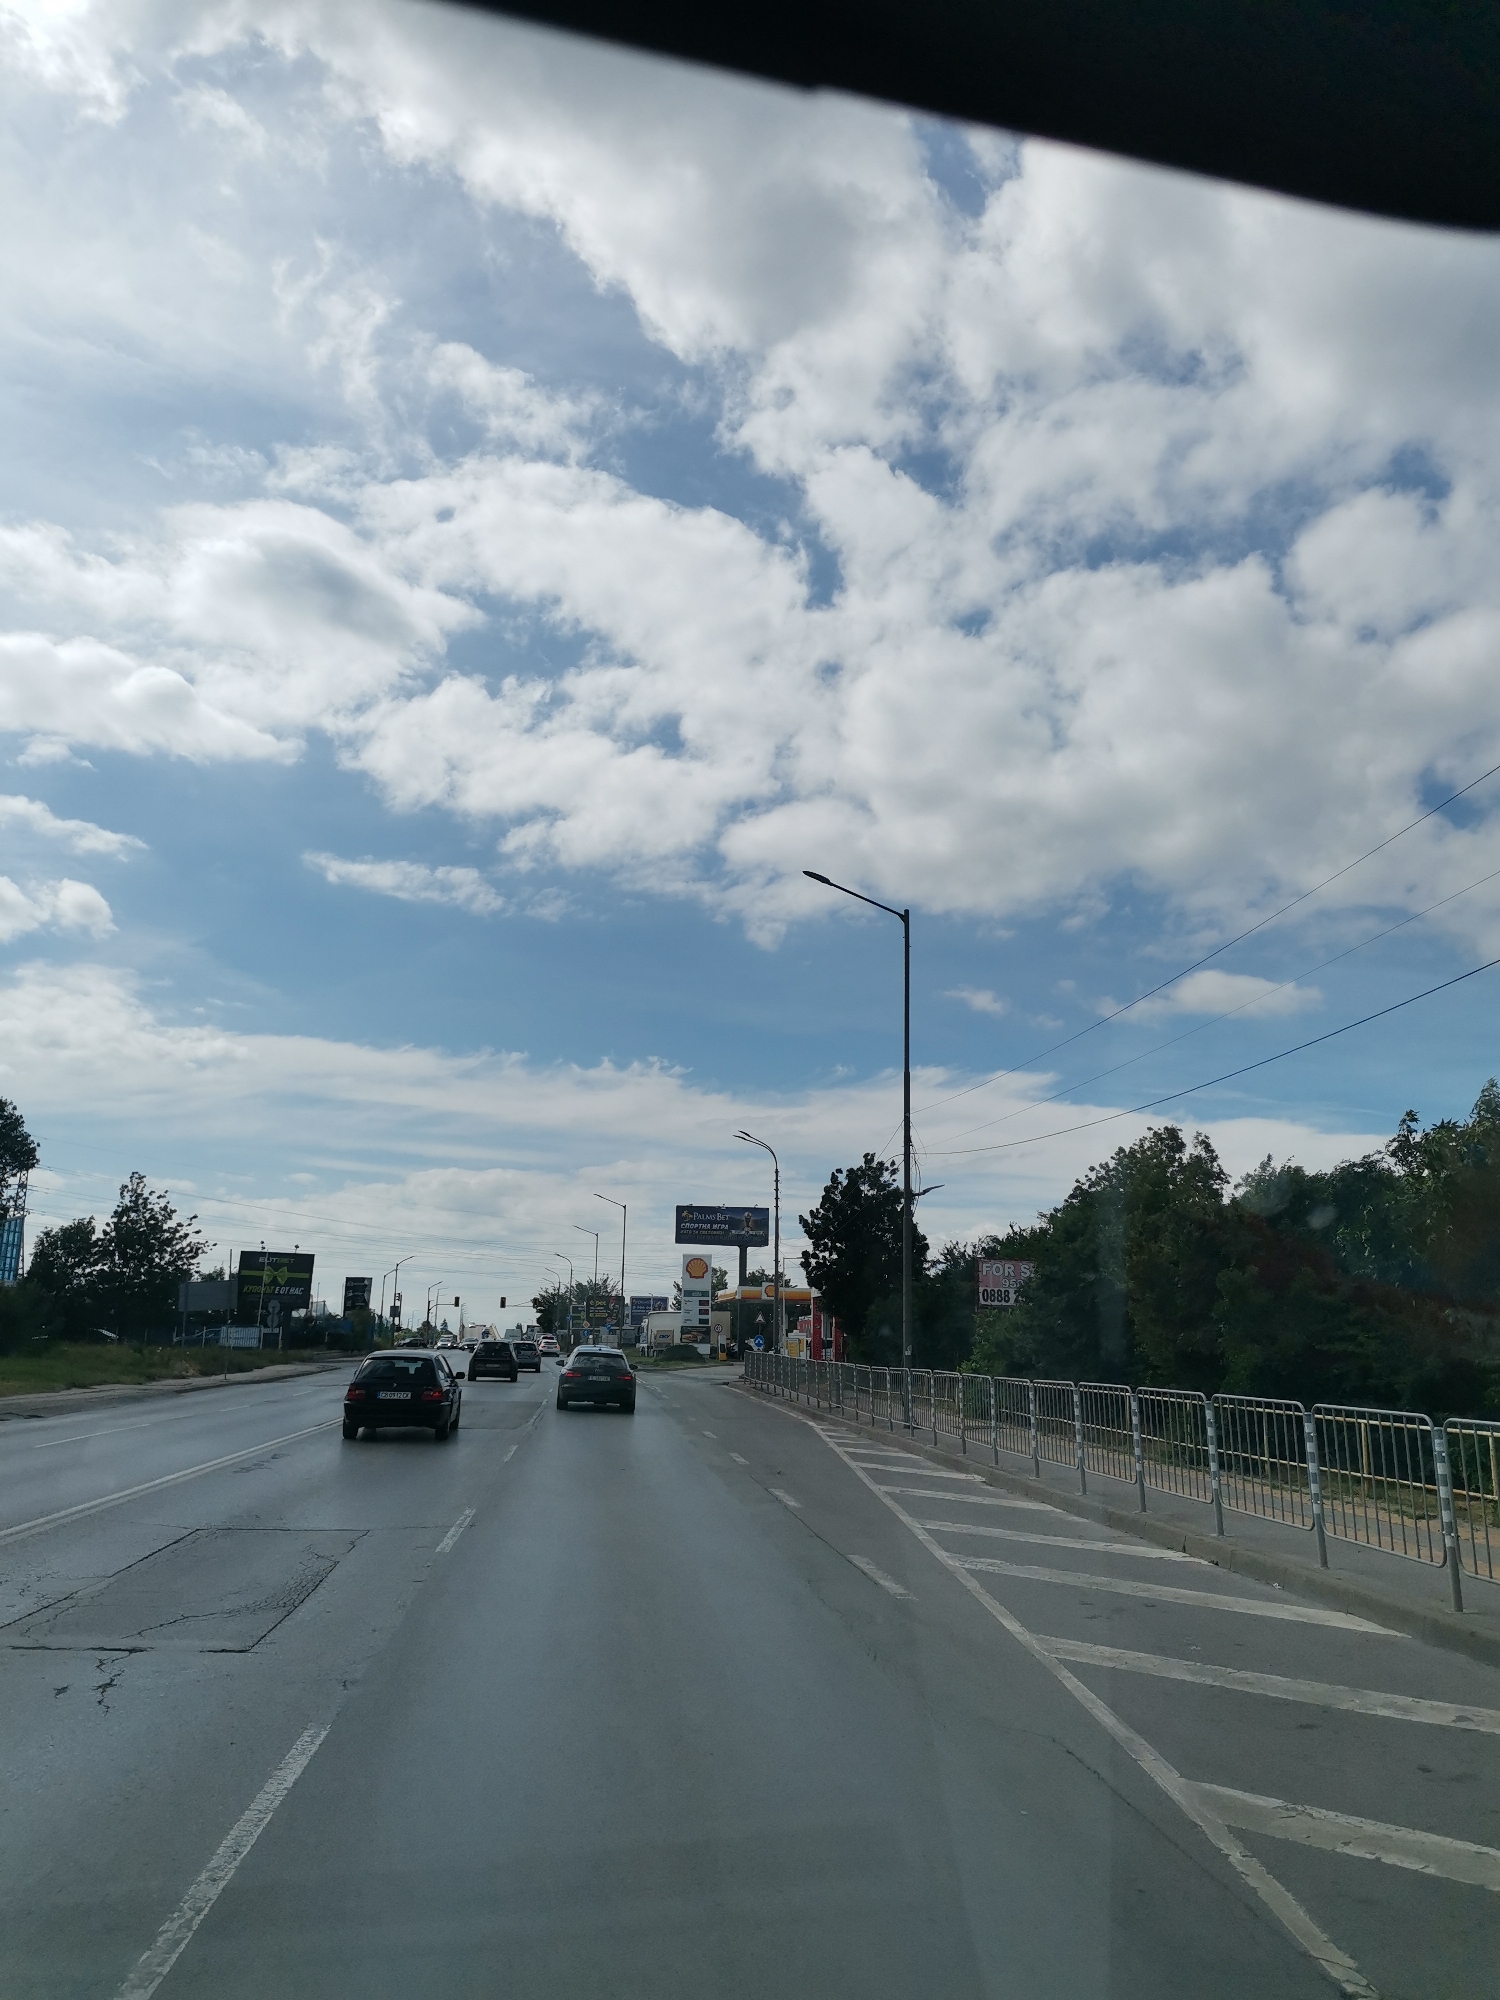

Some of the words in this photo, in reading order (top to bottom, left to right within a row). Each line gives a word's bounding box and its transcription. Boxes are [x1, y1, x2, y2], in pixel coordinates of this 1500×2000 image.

[982, 1263, 1015, 1277] FOR
[289, 1287, 304, 1295] НАС
[982, 1289, 1011, 1303] 0888
